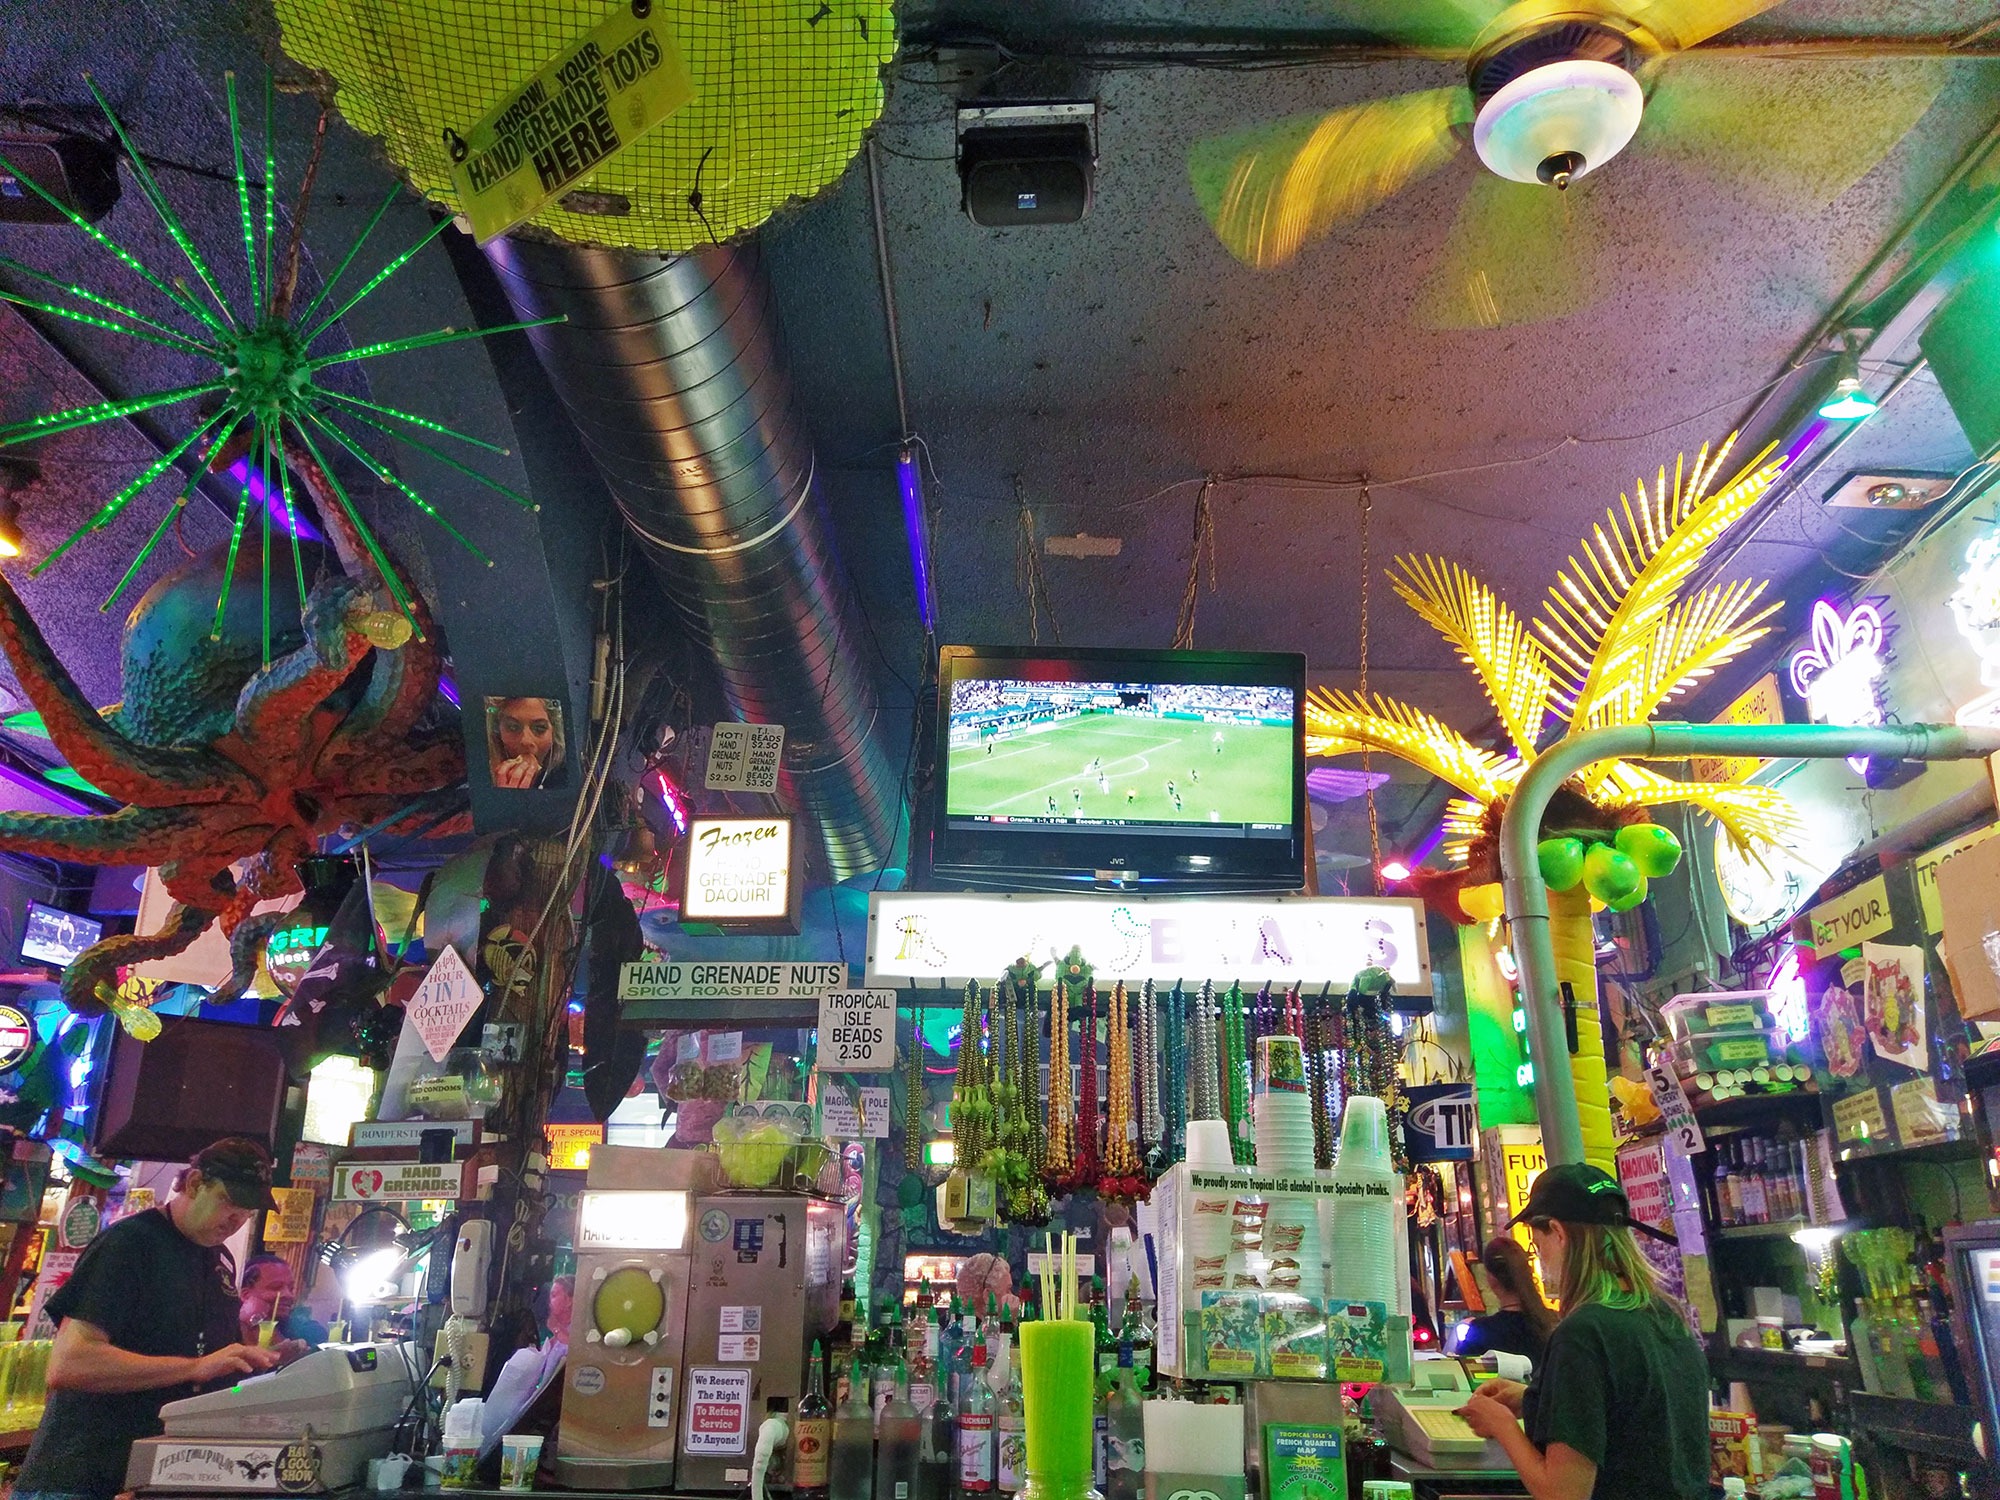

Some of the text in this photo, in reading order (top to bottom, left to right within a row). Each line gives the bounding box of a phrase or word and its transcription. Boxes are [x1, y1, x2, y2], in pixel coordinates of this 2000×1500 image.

[494, 41, 604, 136] THROW YOUR
[465, 29, 662, 195] HAND GRENADE TOYS
[531, 104, 620, 195] HERE
[716, 732, 743, 740] HOT!
[751, 734, 781, 742] BEADS
[718, 740, 737, 749] HAND
[751, 741, 779, 750] $2.50
[711, 750, 741, 760] GRENADE
[749, 758, 776, 766] GRENADE
[715, 761, 733, 771] NUTS
[709, 773, 737, 782] $2.50
[745, 779, 773, 787] $3.50
[746, 772, 775, 780] BEADS
[699, 825, 780, 856] Frozen
[717, 856, 761, 871] HD
[1109, 857, 1125, 865] JVC
[699, 871, 778, 887] GRENADE
[704, 887, 771, 903] DAQUIRI
[1149, 917, 1400, 969] BAS
[429, 970, 464, 984] HOUR
[629, 965, 841, 985] HAND GRENADE NUTS
[419, 984, 429, 1008] 3
[435, 980, 454, 1003] IN
[626, 986, 683, 997] SPICY
[691, 986, 779, 996] ROASTED
[827, 993, 890, 1009] TROPICAL
[413, 1001, 471, 1020] COCKTAILS
[843, 1011, 872, 1026] ISLE
[832, 1027, 883, 1043] BEADS
[839, 1044, 872, 1060] 2.50
[1650, 1068, 1670, 1093] 5
[423, 1085, 462, 1094] CONDOMS
[868, 1097, 888, 1108] POLE
[1657, 1091, 1680, 1105] CHERRY
[1662, 1104, 1686, 1118] BOMBS
[360, 1127, 424, 1140] BUMPERSTI
[569, 1128, 602, 1138] SPECIAL
[401, 1165, 442, 1179] HAND
[1621, 1151, 1659, 1181] SMOKING
[333, 1167, 350, 1200] I
[383, 1178, 459, 1193] GRENADES
[1191, 1175, 1390, 1197] We proudly serve Tropical Isle alcohol in our Specialty Drinks.
[1627, 1180, 1660, 1202] PERMITTED
[695, 1375, 745, 1386] We Reserve
[698, 1390, 740, 1403] The Right
[696, 1405, 739, 1417] To Refuse
[700, 1418, 733, 1429] Service
[797, 1423, 824, 1435] Tito's
[691, 1434, 739, 1447] To Anyone!
[1276, 1438, 1337, 1447] FRENCH QUARTER
[158, 1449, 186, 1476] TEXAS
[277, 1459, 287, 1469] A
[199, 1472, 223, 1482] TEXAS
[281, 1469, 314, 1482] SHOW
[1279, 1473, 1338, 1493] HAND GRENADE
